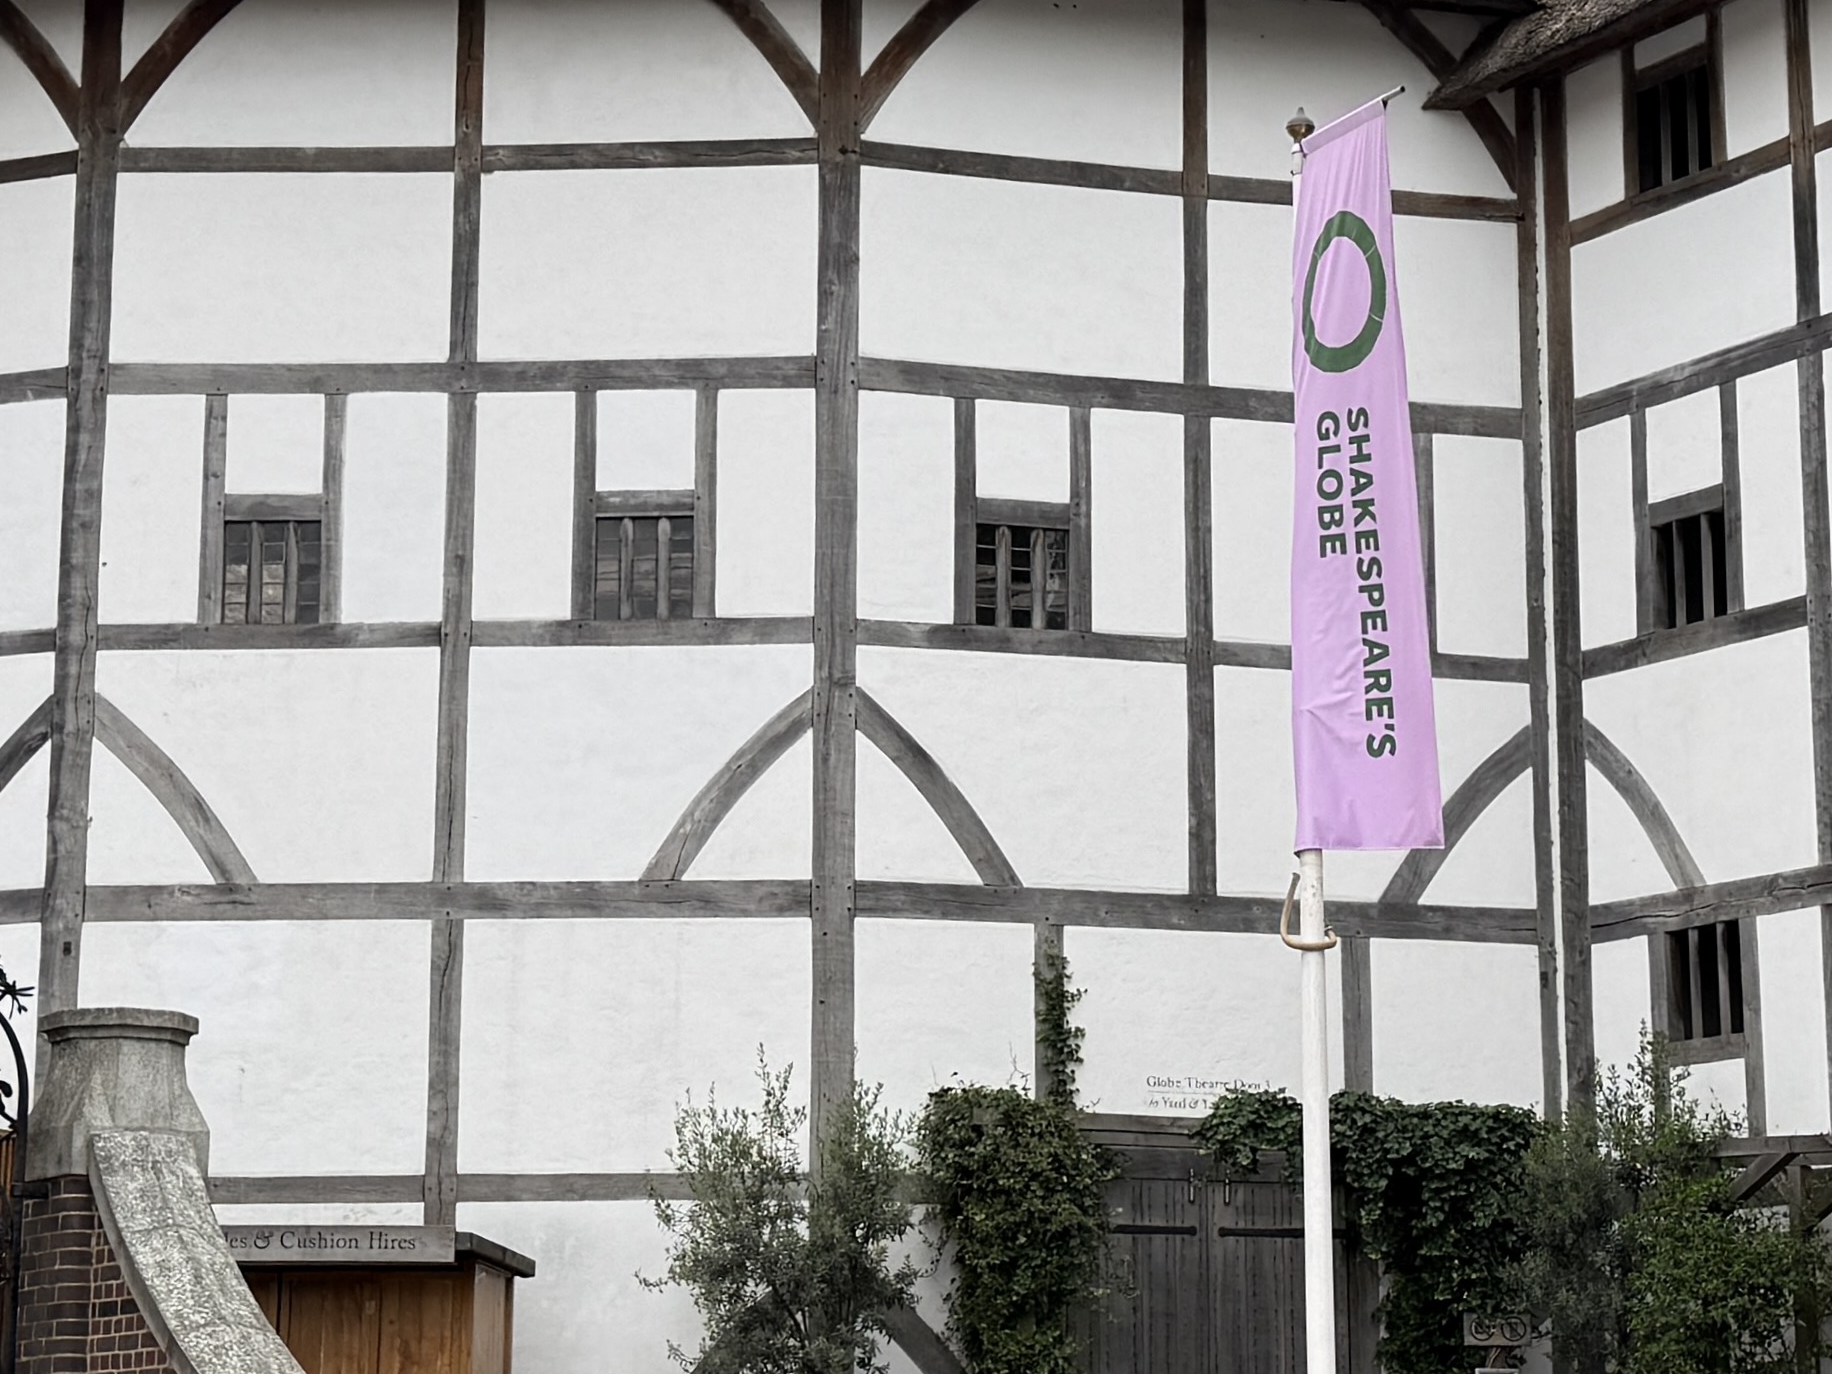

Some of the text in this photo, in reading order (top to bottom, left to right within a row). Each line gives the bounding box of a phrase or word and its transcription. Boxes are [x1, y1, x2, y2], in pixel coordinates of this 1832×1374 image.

[1316, 411, 1348, 559] GLOBE
[1345, 407, 1396, 758] SHAKESPEARE'S
[254, 1230, 274, 1249] &
[280, 1231, 359, 1249] Cushion
[369, 1231, 416, 1250] Hires
